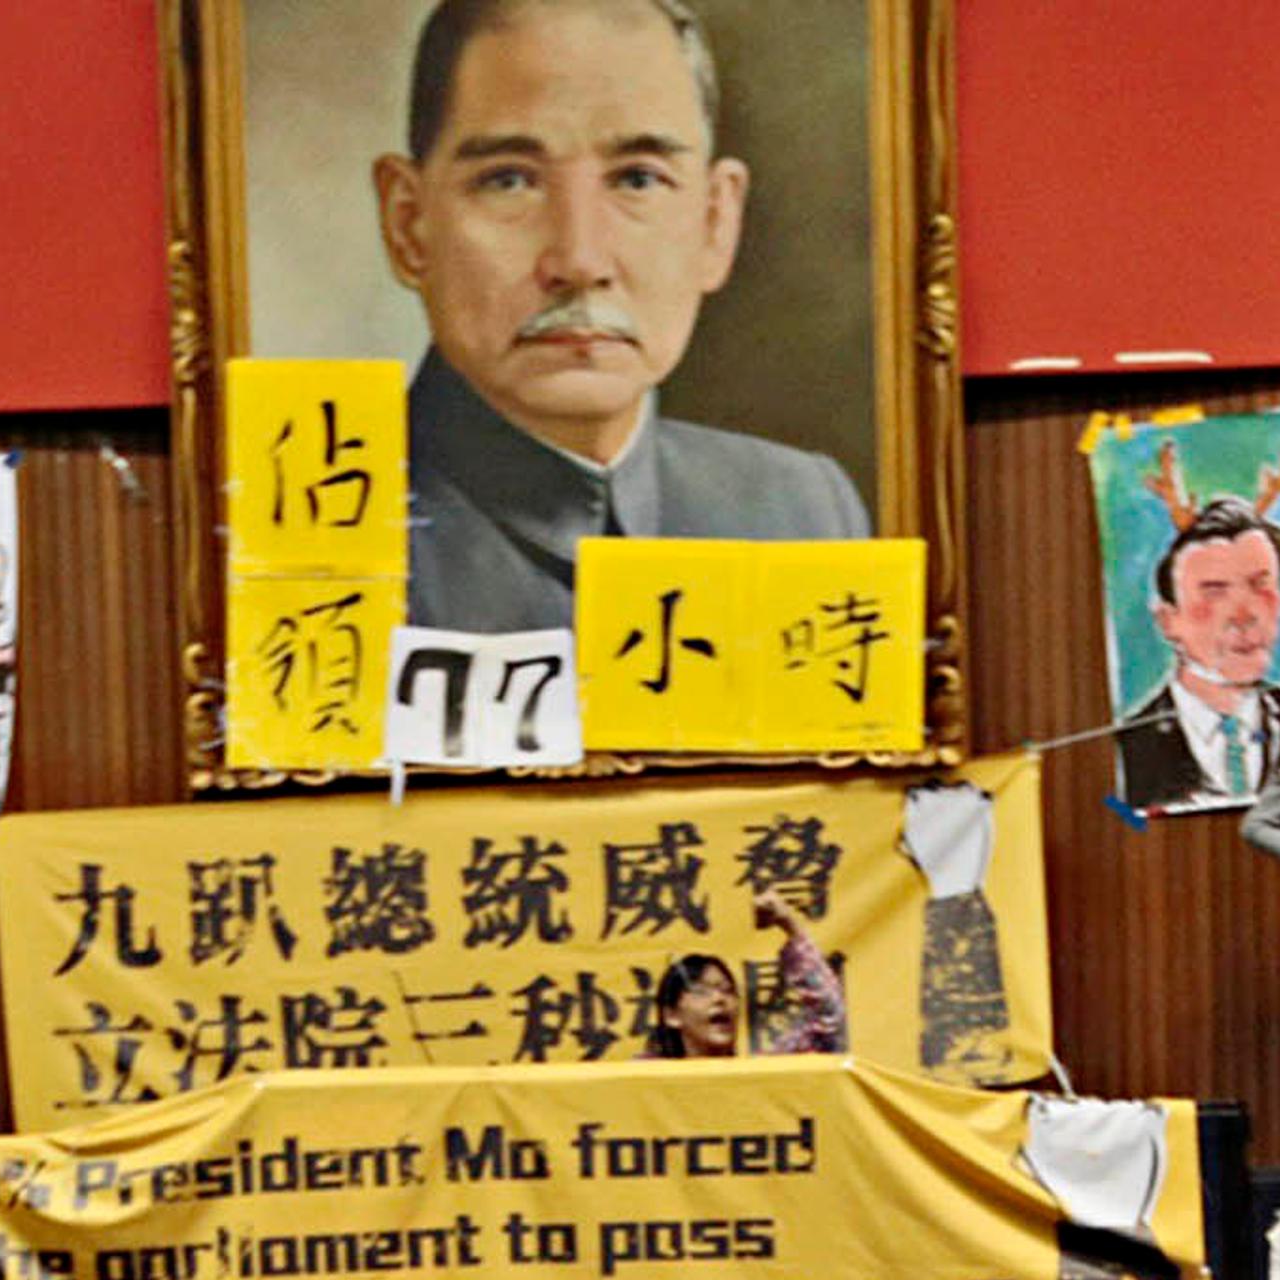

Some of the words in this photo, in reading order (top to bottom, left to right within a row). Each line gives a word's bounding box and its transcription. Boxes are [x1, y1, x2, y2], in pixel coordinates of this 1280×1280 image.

[257, 399, 372, 736] 佔領
[397, 647, 563, 757] 77
[616, 587, 891, 703] 小時
[72, 1136, 426, 1211] President
[570, 1116, 817, 1179] forced
[502, 1212, 577, 1264] to
[599, 1217, 776, 1277] pass
